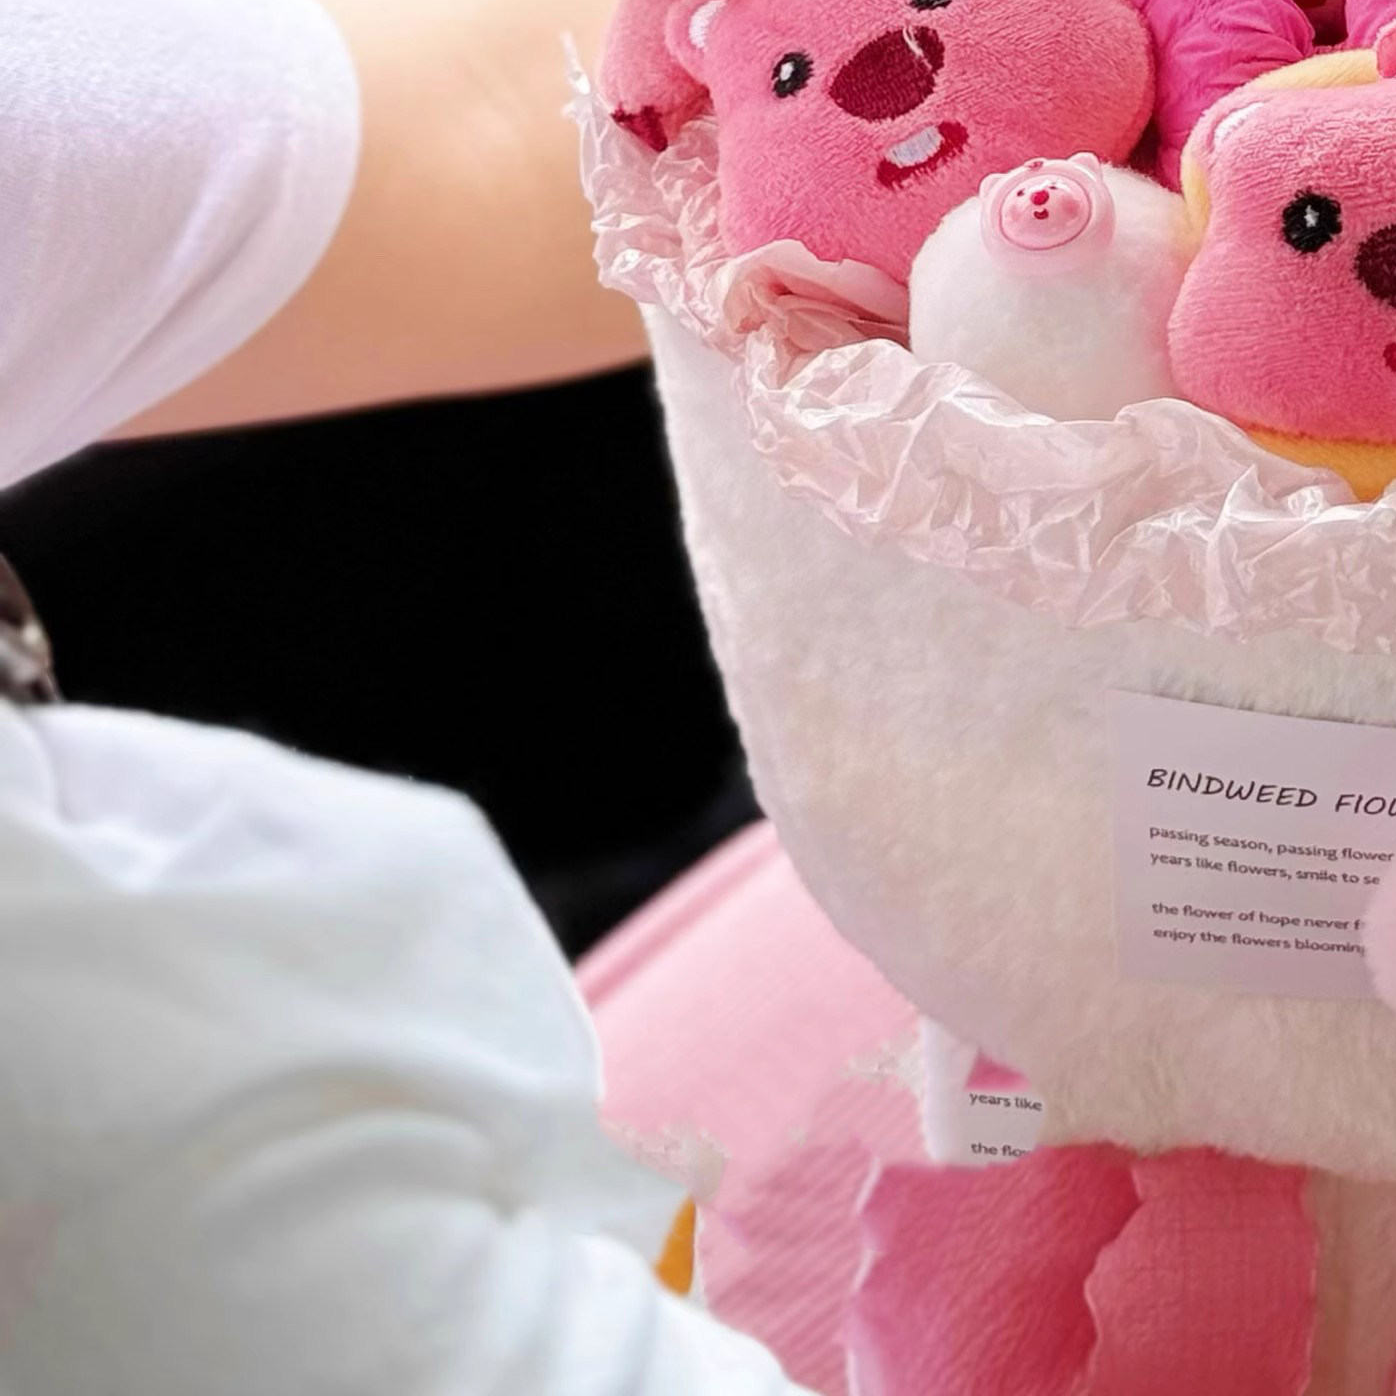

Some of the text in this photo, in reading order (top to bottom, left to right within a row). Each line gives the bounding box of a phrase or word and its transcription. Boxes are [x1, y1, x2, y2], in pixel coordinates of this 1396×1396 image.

[1147, 768, 1318, 807] BINDWEED
[1149, 826, 1394, 861] passing season, passing flower
[1150, 852, 1192, 868] years
[1196, 856, 1223, 871] like
[1227, 860, 1292, 880] flowers,
[1296, 869, 1337, 883] smile
[1341, 872, 1359, 883] to
[1151, 902, 1179, 915] the
[1182, 904, 1234, 920] flower
[1238, 910, 1255, 922] of
[1259, 911, 1301, 927] hope
[1304, 917, 1350, 930] never
[1153, 928, 1196, 944] enjoy
[1200, 931, 1227, 943] the
[1232, 932, 1291, 949] flowers
[969, 1092, 1042, 1111] years like
[971, 1142, 998, 1155] the
